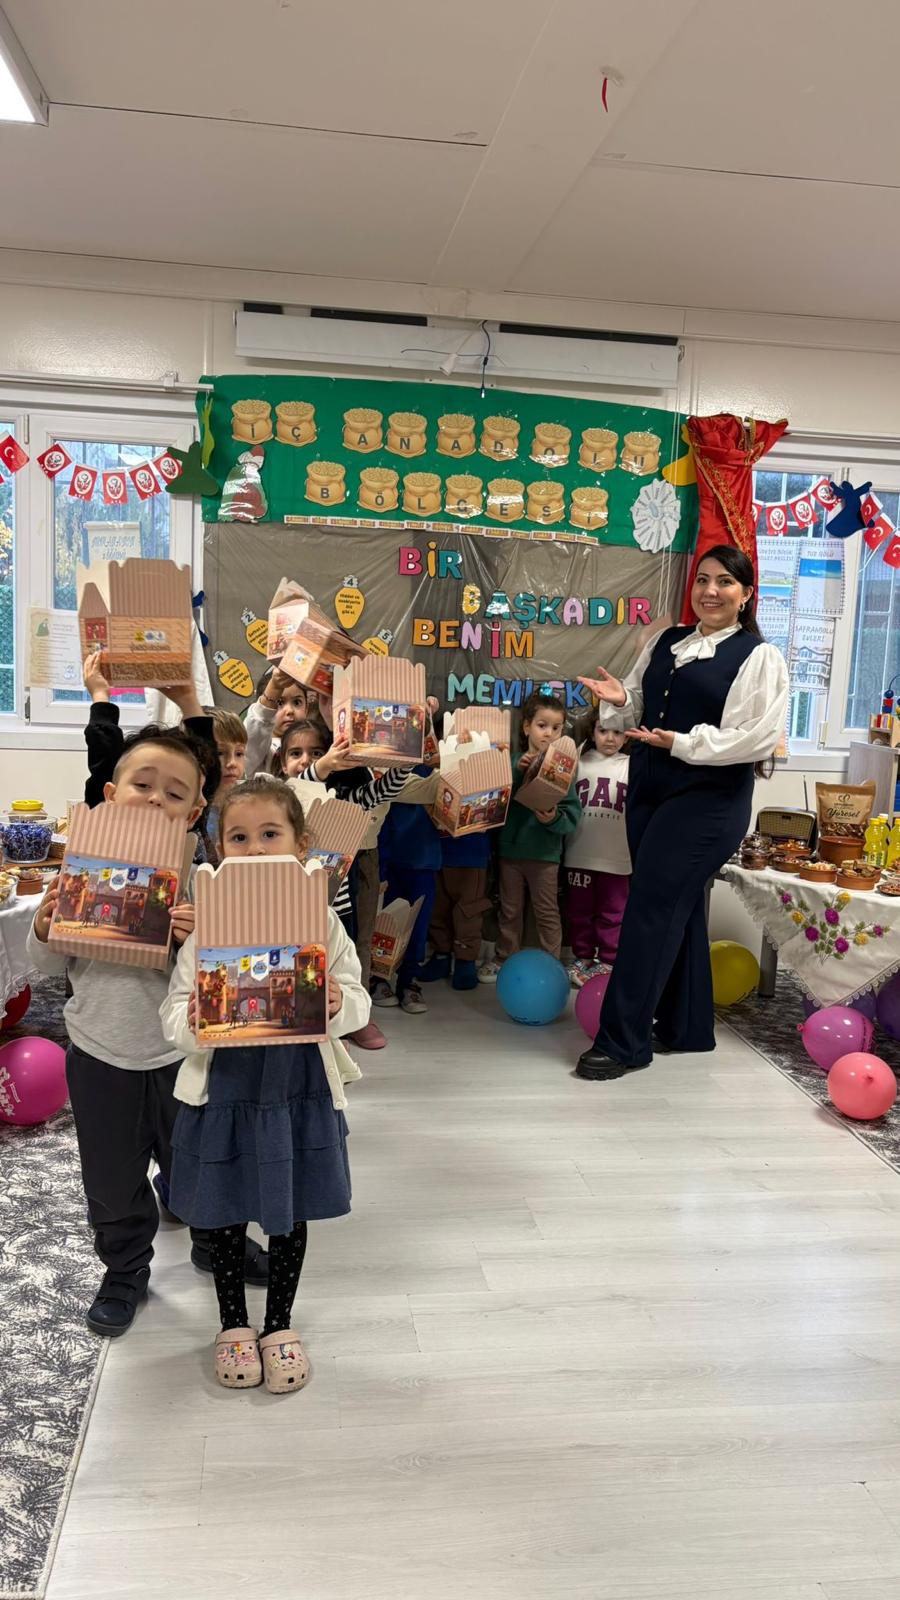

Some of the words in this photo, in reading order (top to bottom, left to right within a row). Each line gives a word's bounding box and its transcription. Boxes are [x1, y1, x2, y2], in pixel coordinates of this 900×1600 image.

[357, 434, 645, 467] ANADOLU
[398, 541, 463, 580] BİR
[346, 578, 354, 587] 4
[245, 614, 254, 623] 2
[461, 582, 652, 629] BAŞKADIR
[382, 632, 390, 640] 5
[412, 617, 535, 659] BENİM
[575, 776, 629, 814] GAP
[568, 872, 592, 889] GAP
